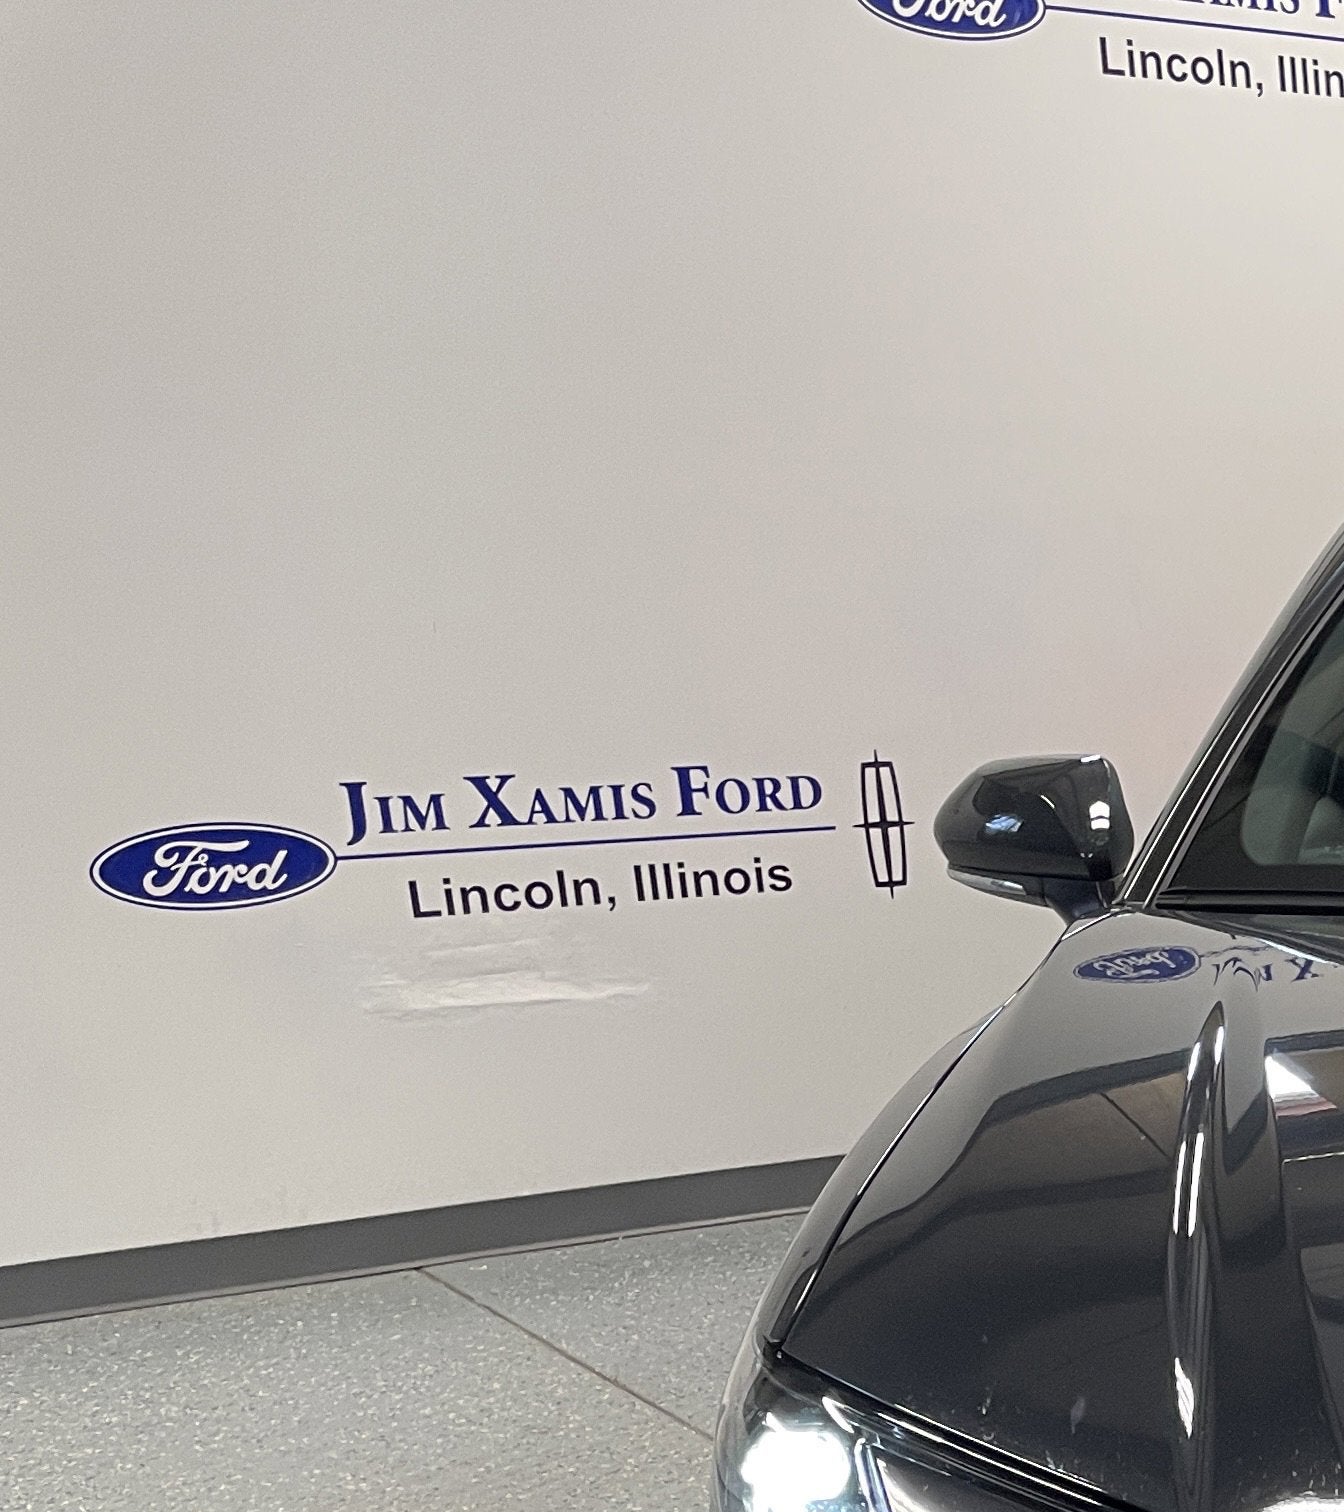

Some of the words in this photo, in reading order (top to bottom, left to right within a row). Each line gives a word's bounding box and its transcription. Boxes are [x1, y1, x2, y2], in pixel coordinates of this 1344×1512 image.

[1099, 36, 1264, 98] Lincoln,
[143, 840, 288, 897] Ford
[408, 869, 617, 919] Lincoln,
[633, 856, 793, 903] Illinois
